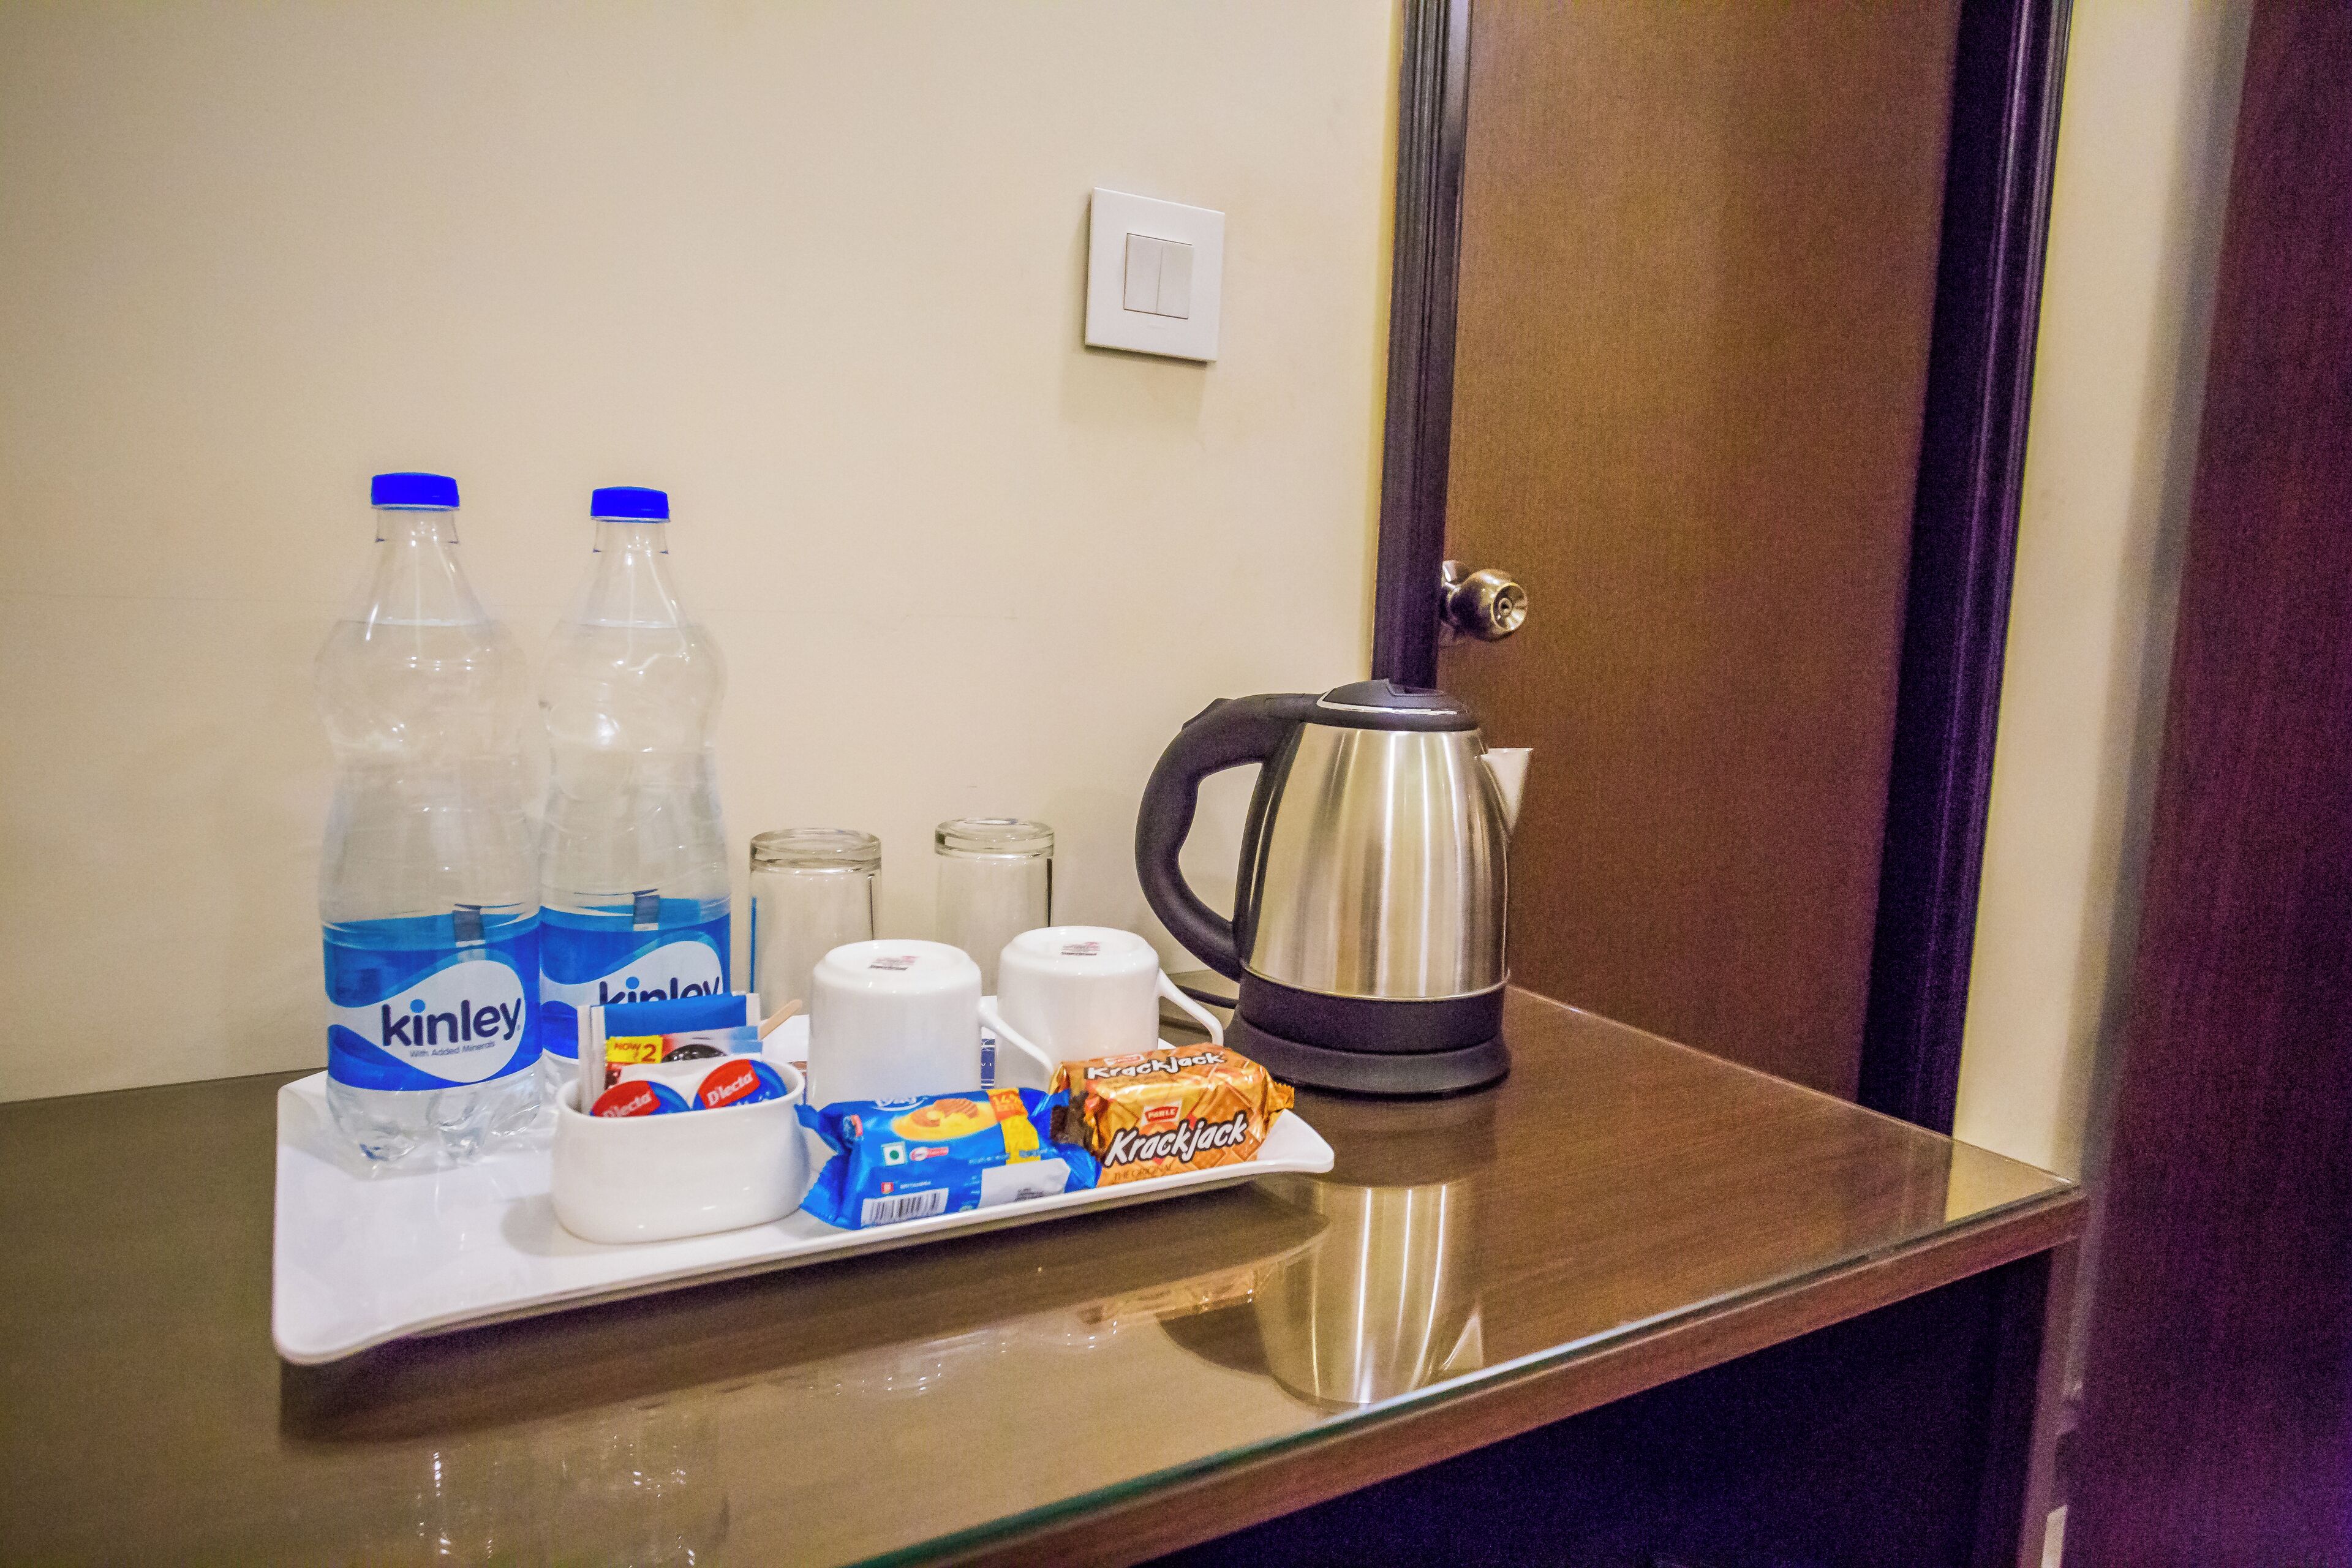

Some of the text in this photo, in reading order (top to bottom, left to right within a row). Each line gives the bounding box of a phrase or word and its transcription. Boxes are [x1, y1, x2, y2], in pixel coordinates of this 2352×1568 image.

[381, 997, 521, 1047] kinley
[431, 1046, 460, 1056] Added
[462, 1041, 496, 1053] Minerals
[1147, 1108, 1175, 1120] PARLE
[1104, 1113, 1248, 1167] Krackjack
